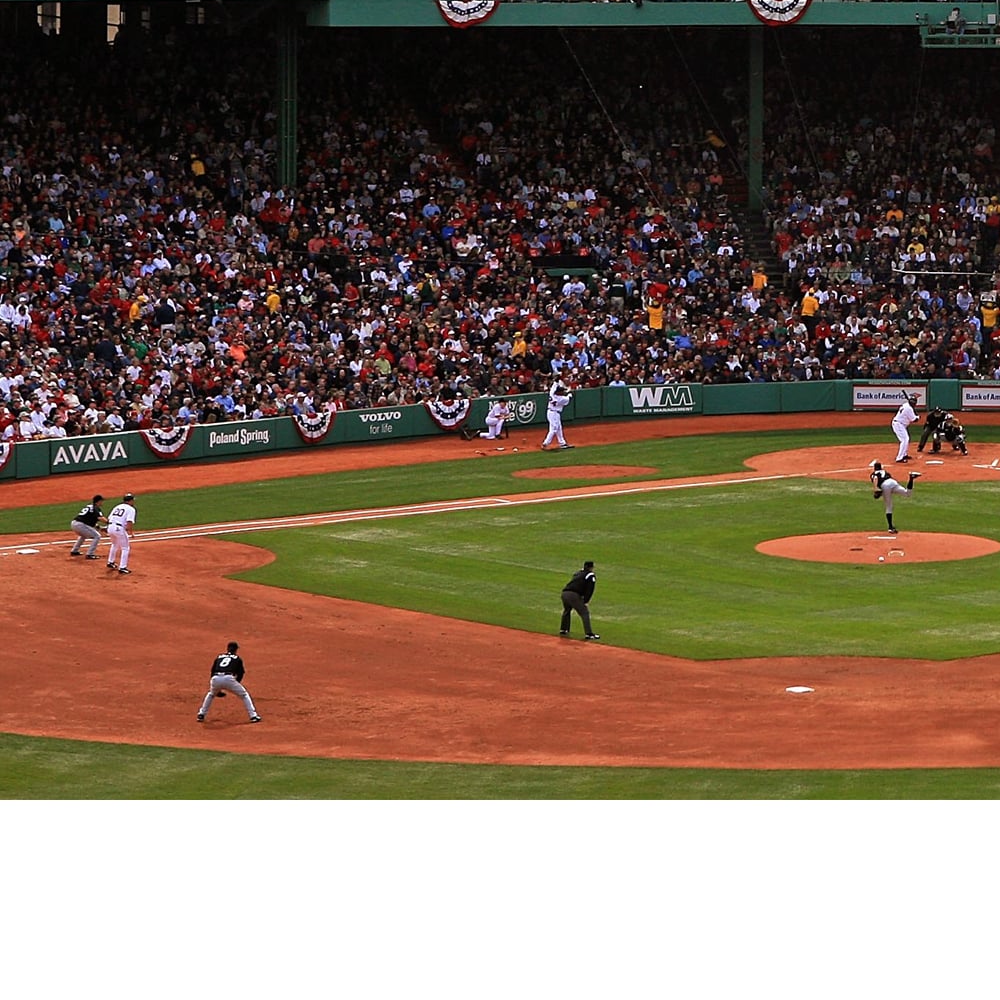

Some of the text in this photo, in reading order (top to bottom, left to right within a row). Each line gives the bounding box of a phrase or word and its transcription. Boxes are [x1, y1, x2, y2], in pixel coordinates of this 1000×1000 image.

[629, 386, 693, 407] WM
[359, 411, 401, 422] VOLVO
[519, 401, 534, 417] 99
[370, 423, 393, 434] for life
[209, 428, 269, 448] Poland Spring
[52, 440, 127, 466] AVAYA
[220, 658, 231, 667] 8
